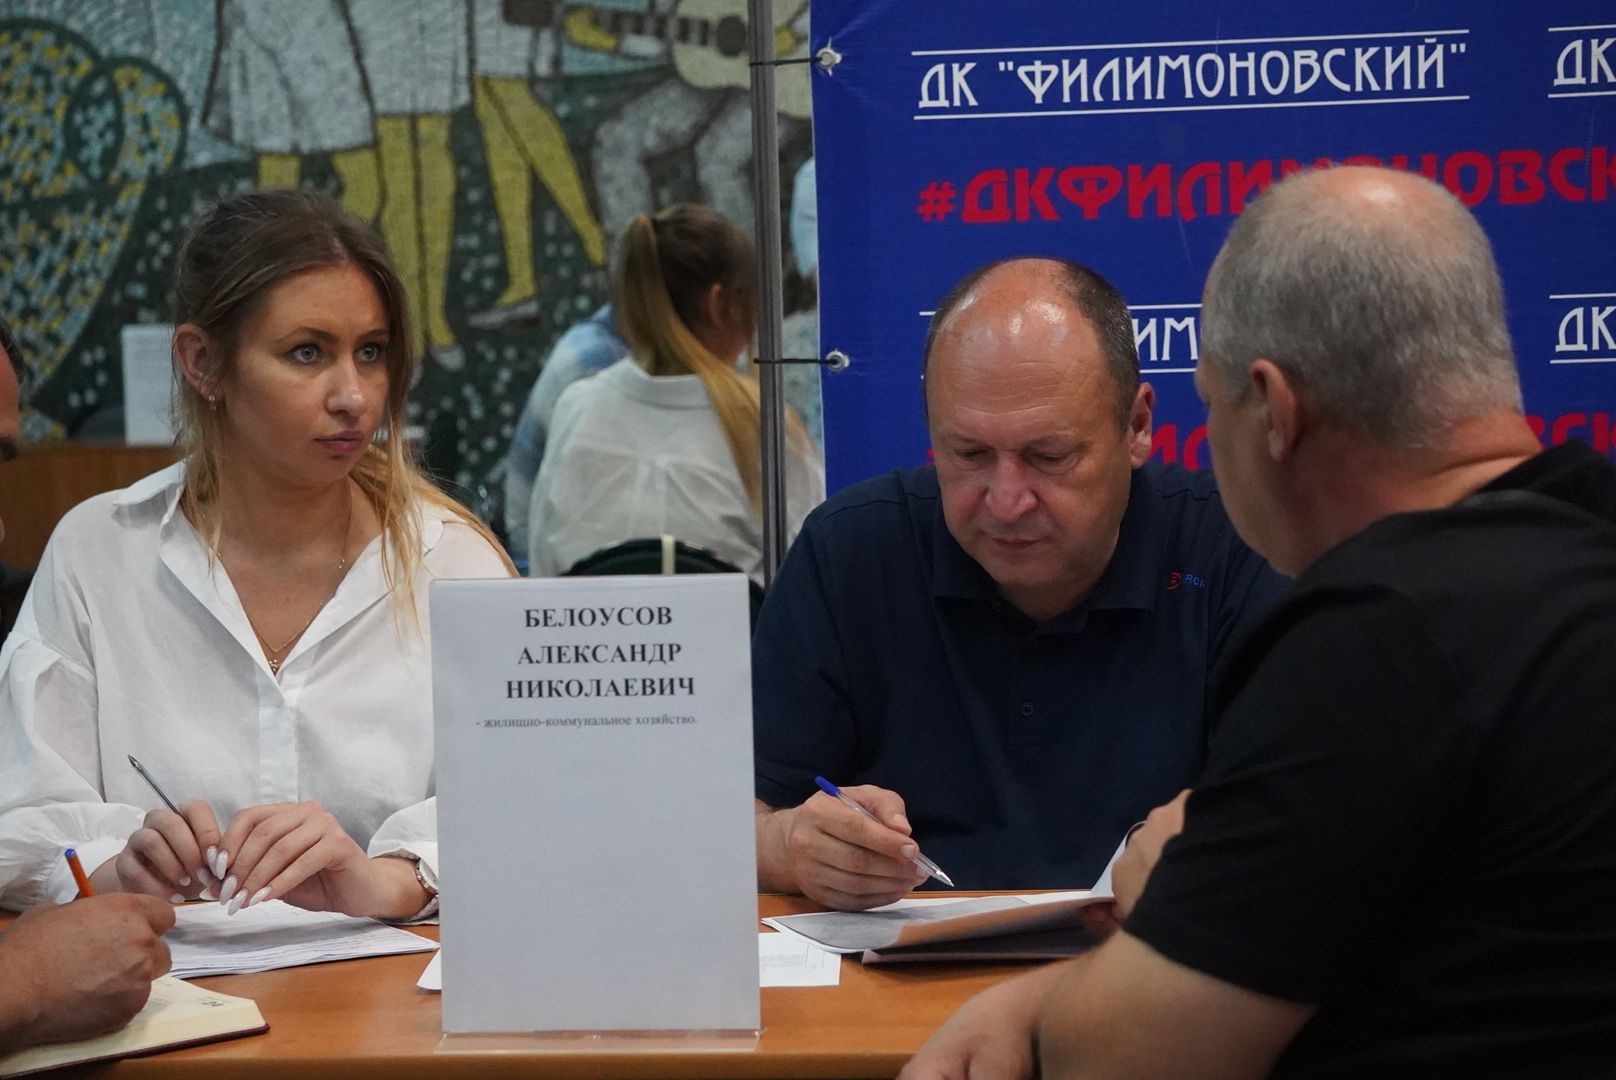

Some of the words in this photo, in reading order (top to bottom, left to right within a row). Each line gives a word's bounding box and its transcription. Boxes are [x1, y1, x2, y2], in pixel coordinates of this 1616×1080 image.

[918, 62, 979, 108] ДК
[998, 37, 1467, 104] "ФИЛИМОНОВСКИЙ"
[1553, 37, 1616, 86] ДК
[1555, 305, 1616, 352] ДК
[524, 606, 672, 628] БЕЛОУСОВ
[517, 643, 682, 665] АЛЕКСАНДР
[506, 677, 695, 699] НИКОЛАЕВИЧ
